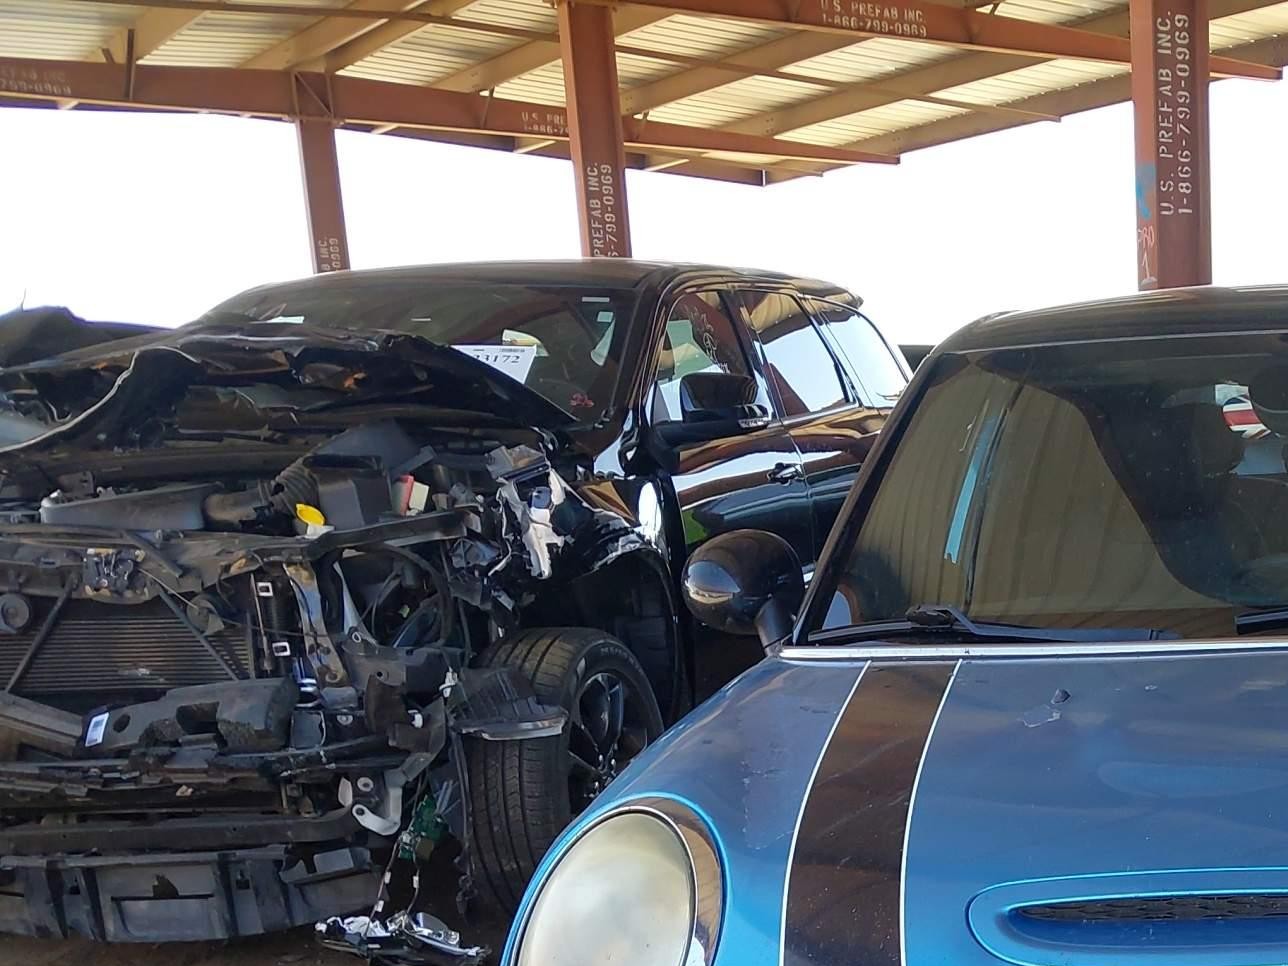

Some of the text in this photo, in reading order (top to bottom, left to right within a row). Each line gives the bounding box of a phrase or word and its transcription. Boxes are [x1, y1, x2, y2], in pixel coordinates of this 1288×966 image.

[851, 2, 898, 20] PREFAB
[1156, 10, 1174, 215] U.S. PREFAB INC.
[1174, 14, 1192, 214] 1-866-799-0969
[587, 162, 605, 257] PREFAB INC.
